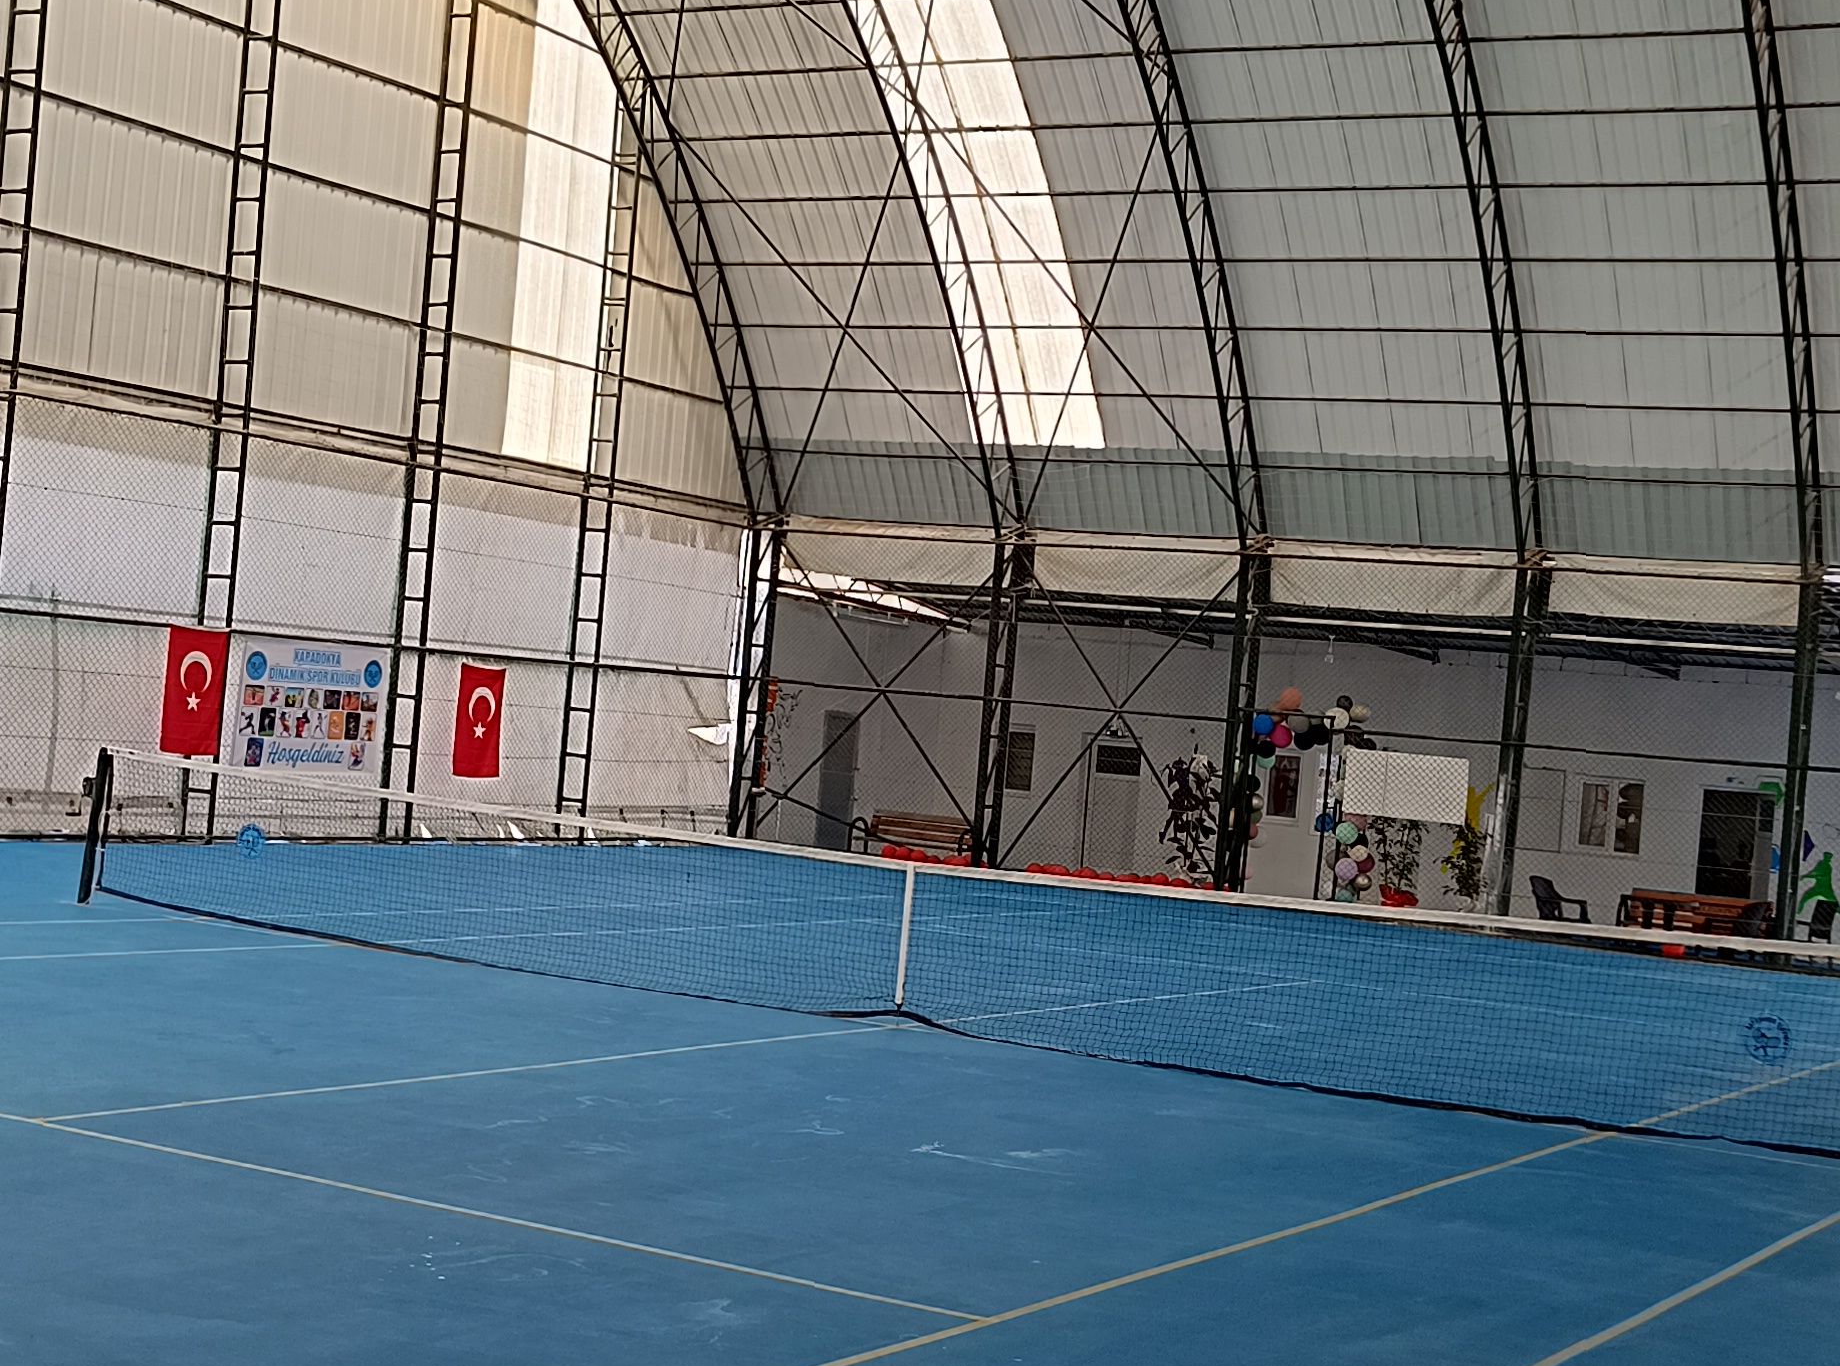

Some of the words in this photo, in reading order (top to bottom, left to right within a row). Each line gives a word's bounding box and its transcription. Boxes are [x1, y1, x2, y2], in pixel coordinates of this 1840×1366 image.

[294, 649, 341, 667] KAPADOKYA
[307, 668, 330, 684] SPOR
[267, 741, 345, 768] Hoşgeldiniz
